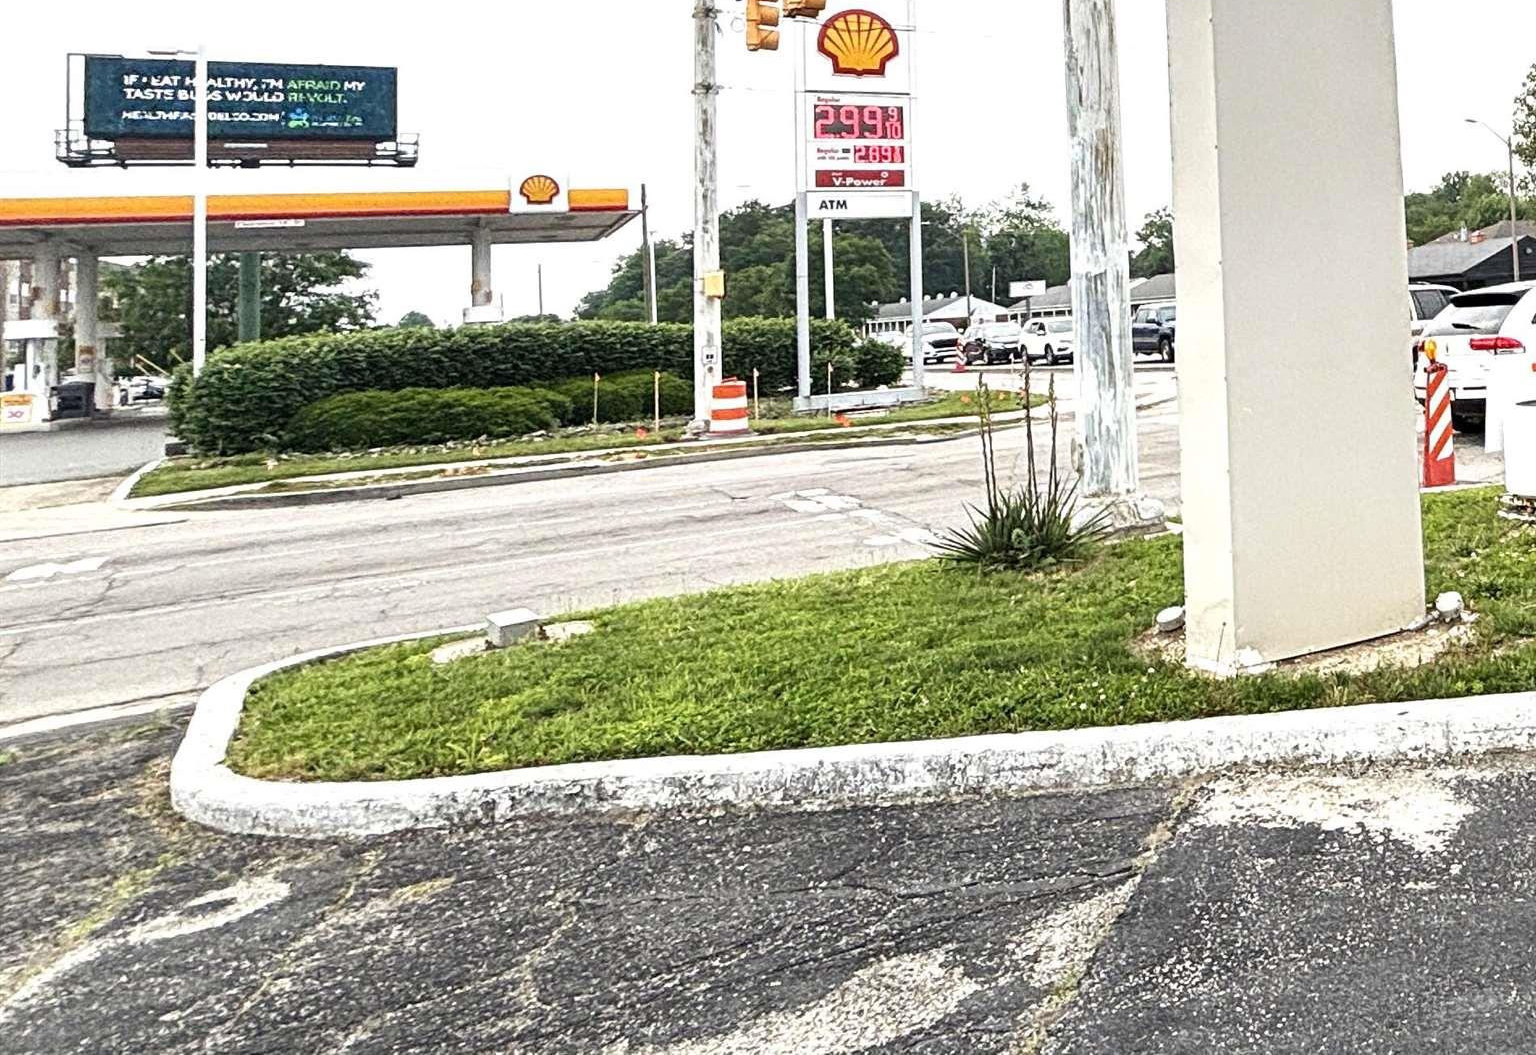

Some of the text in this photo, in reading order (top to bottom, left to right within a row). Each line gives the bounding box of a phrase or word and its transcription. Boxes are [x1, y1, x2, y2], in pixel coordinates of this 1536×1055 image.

[150, 75, 181, 87] EAT
[185, 76, 258, 91] HALTHY,
[287, 79, 341, 91] AFRAID
[343, 80, 366, 92] MY
[123, 88, 175, 100] TASTE
[177, 90, 223, 102] BUS
[225, 91, 284, 103] WOULD
[832, 176, 887, 186] V-Power
[819, 199, 848, 210] ATM
